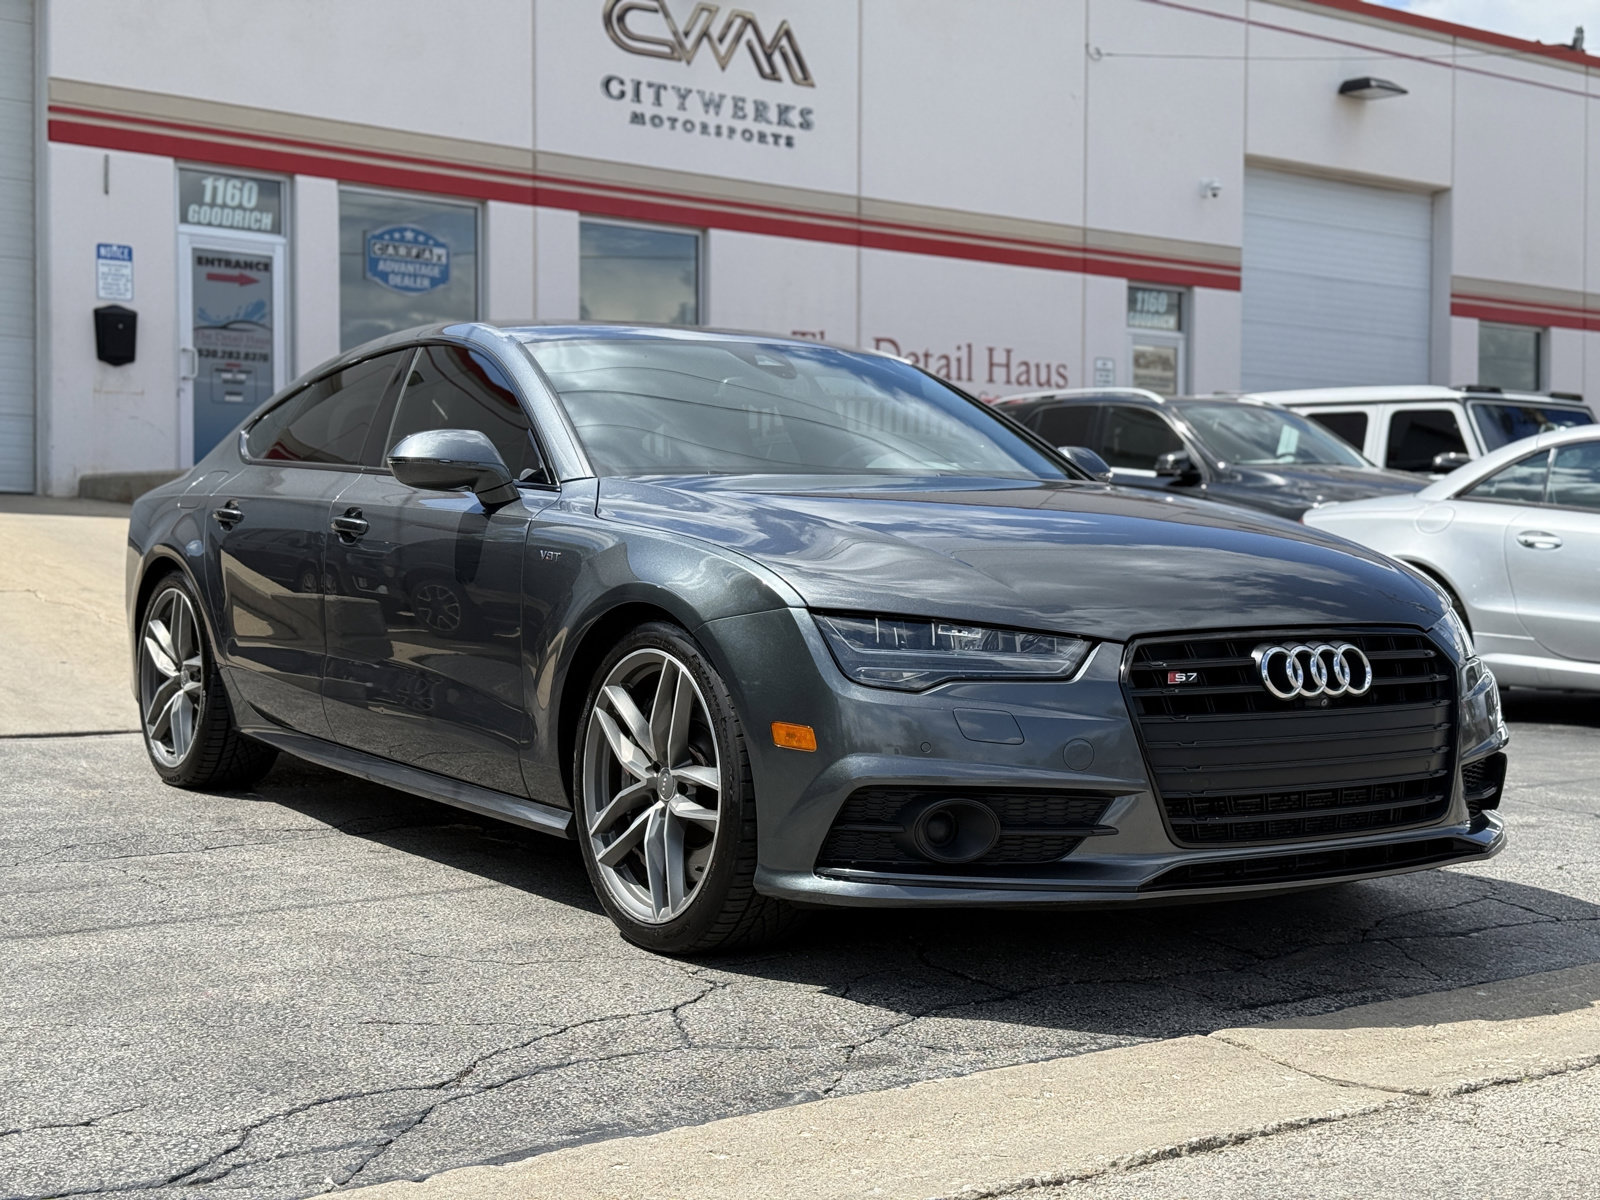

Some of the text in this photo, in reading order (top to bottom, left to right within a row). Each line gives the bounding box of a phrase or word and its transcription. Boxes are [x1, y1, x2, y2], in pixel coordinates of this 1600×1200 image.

[601, 74, 815, 131] CITYWERKS
[629, 111, 795, 149] MOTORSPORTS
[202, 176, 259, 210] 1160
[187, 203, 273, 231] GOODRICH
[196, 255, 271, 273] ENTRANCE
[372, 241, 447, 265] CARFAX
[1135, 290, 1168, 314] 1160
[986, 346, 1069, 389] Haus
[1175, 672, 1197, 682] S7
